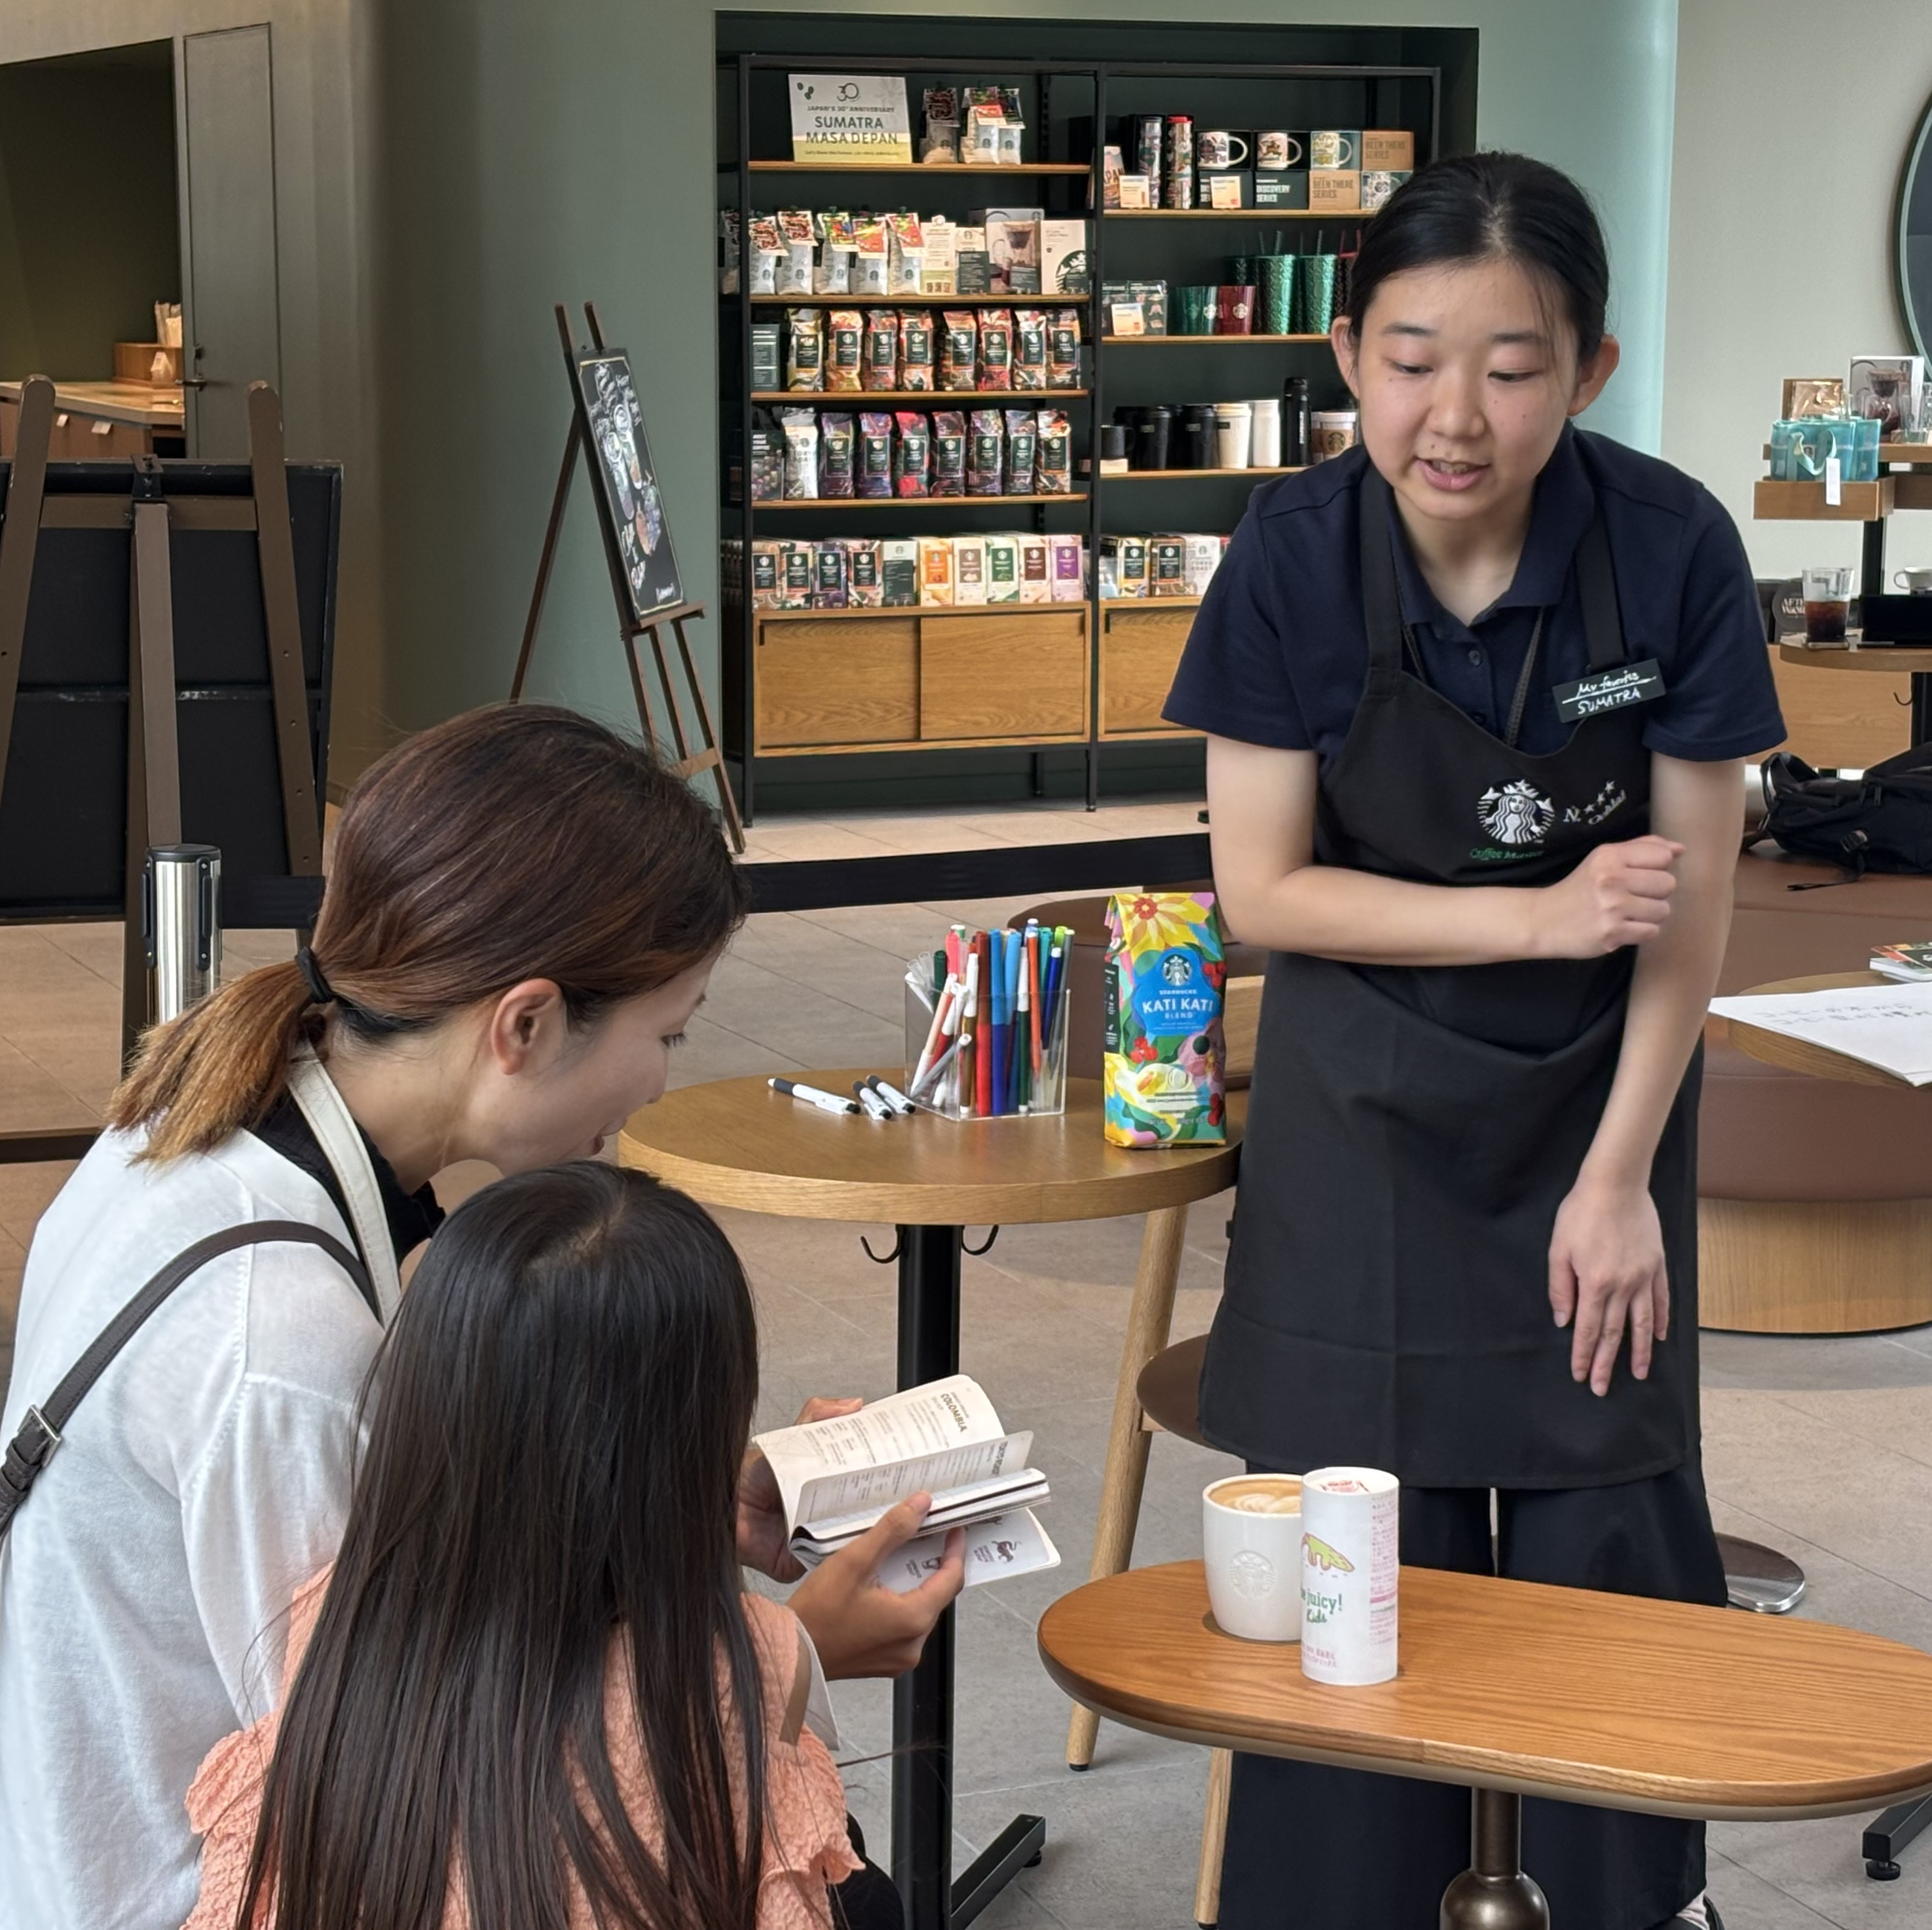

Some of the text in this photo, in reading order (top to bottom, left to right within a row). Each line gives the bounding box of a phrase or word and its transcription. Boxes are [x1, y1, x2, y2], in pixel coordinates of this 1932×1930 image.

[815, 117, 883, 128] SUMATRA
[806, 132, 898, 144] MASA DEPAN
[1578, 688, 1641, 714] SUMATRA
[1142, 998, 1213, 1014] KATI KATI
[940, 1394, 968, 1432] COLOMBIA
[1307, 1587, 1342, 1614] juicy!
